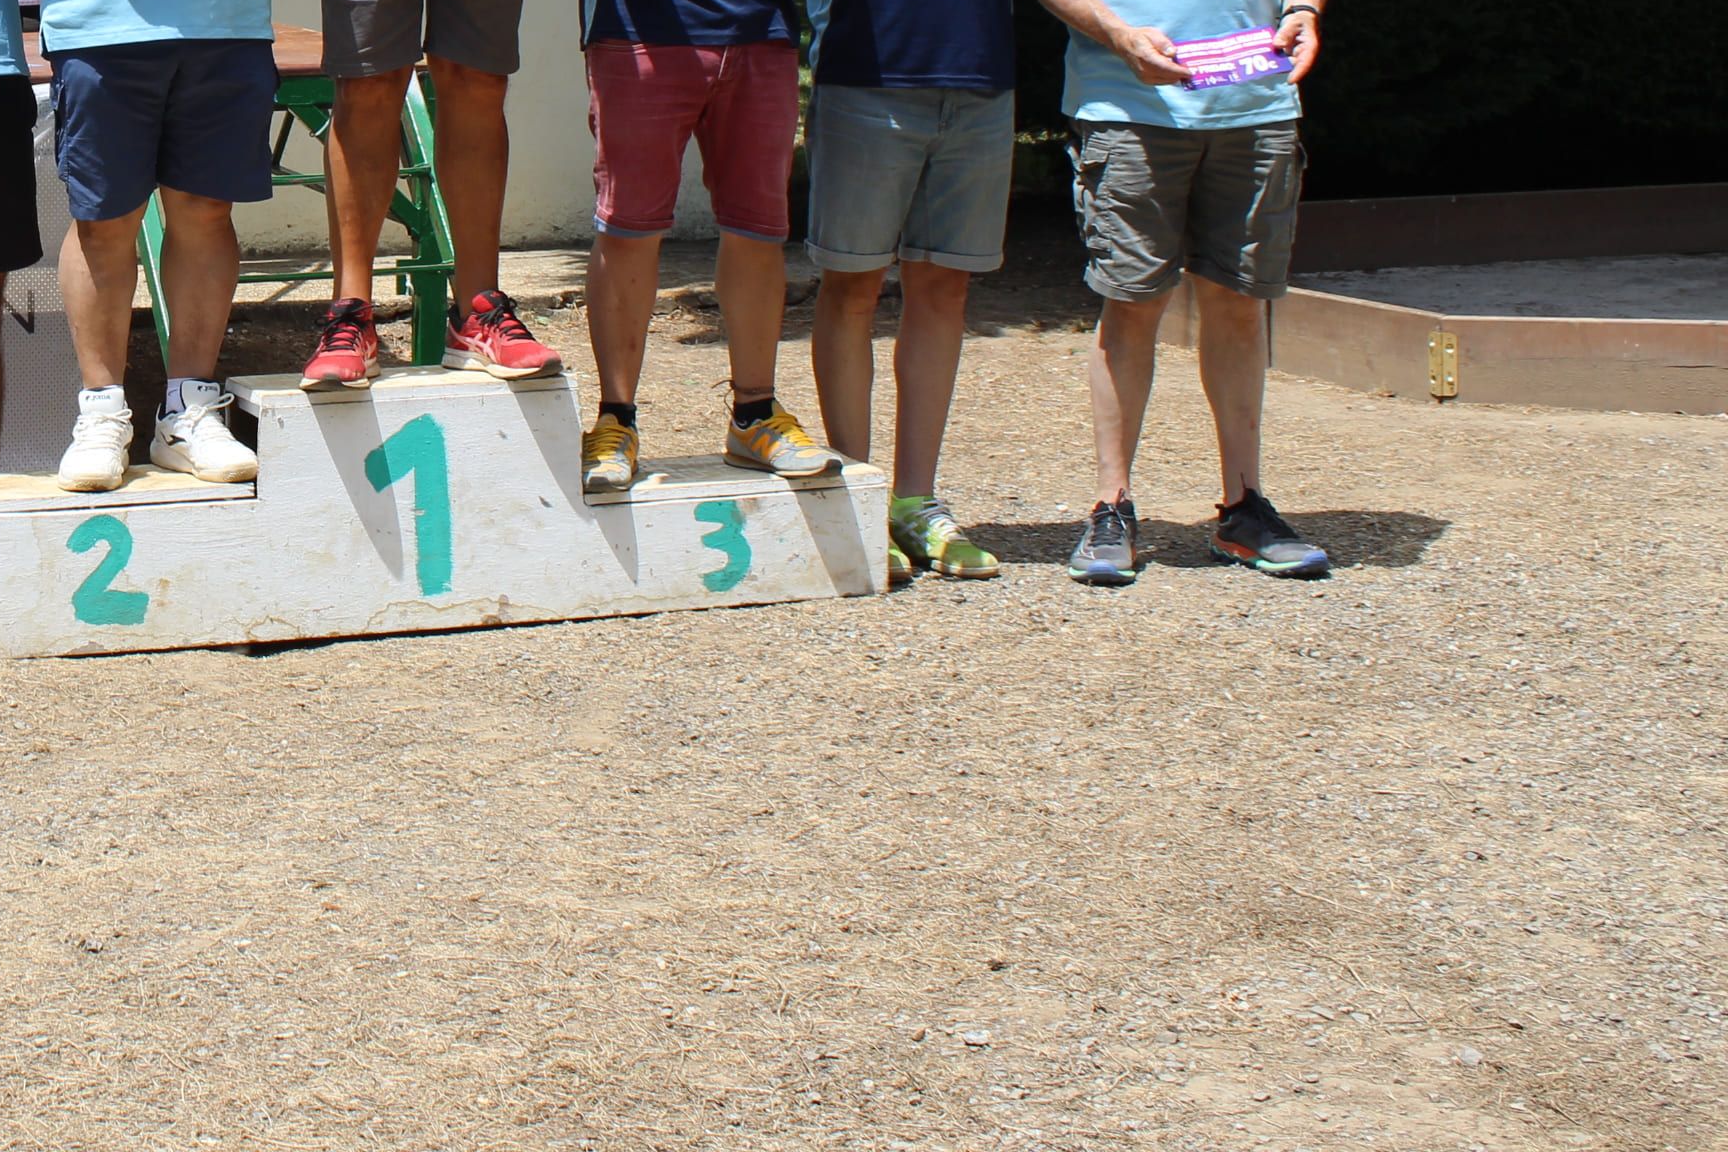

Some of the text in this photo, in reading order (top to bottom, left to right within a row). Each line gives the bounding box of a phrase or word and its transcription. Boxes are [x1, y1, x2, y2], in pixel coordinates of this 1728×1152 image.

[364, 413, 453, 597] 1
[694, 500, 751, 592] 3
[66, 515, 149, 626] 2
